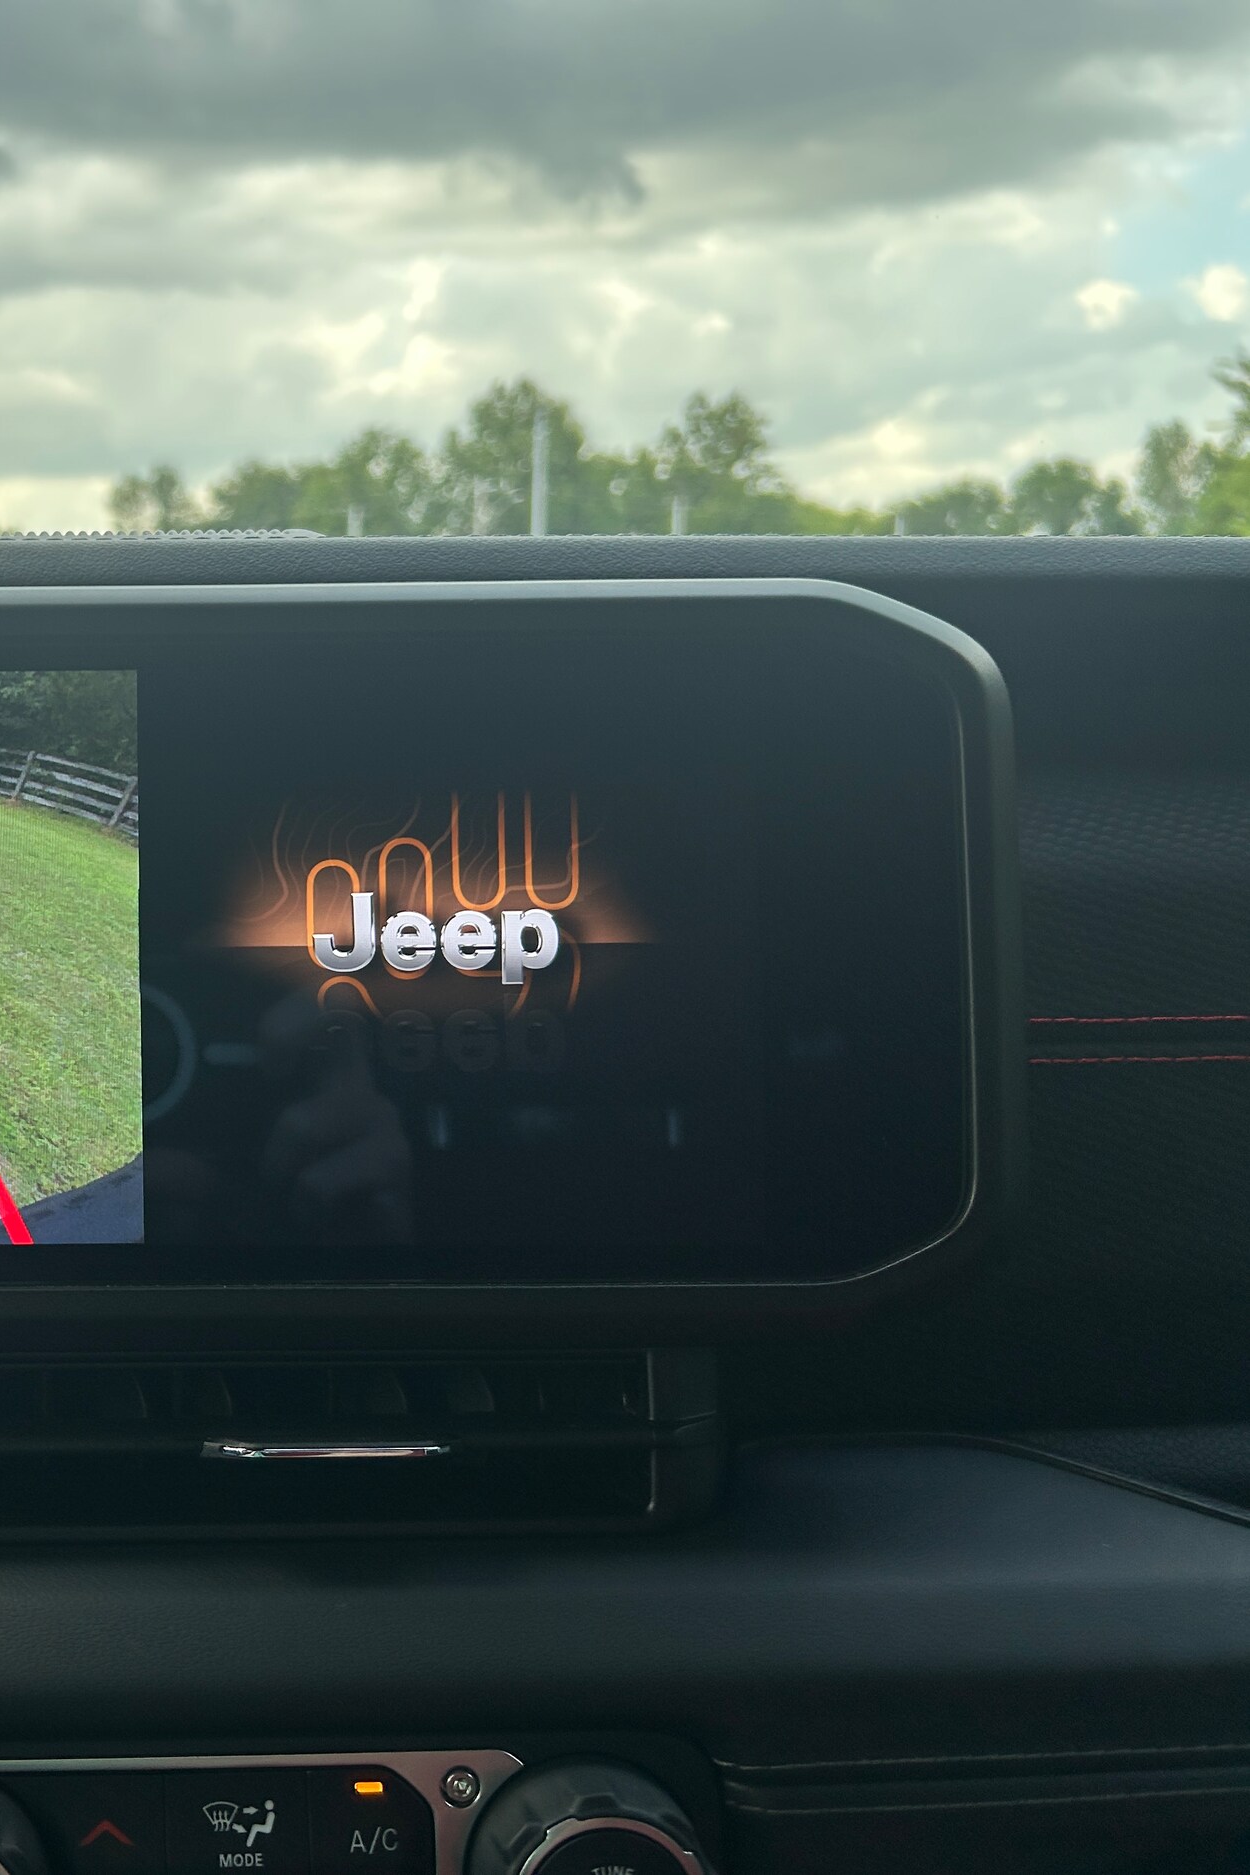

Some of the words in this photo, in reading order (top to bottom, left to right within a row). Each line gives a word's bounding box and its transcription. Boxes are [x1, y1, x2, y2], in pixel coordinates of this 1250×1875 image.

[312, 891, 560, 985] Jeep
[350, 1826, 399, 1855] A/C
[219, 1852, 264, 1868] MODE
